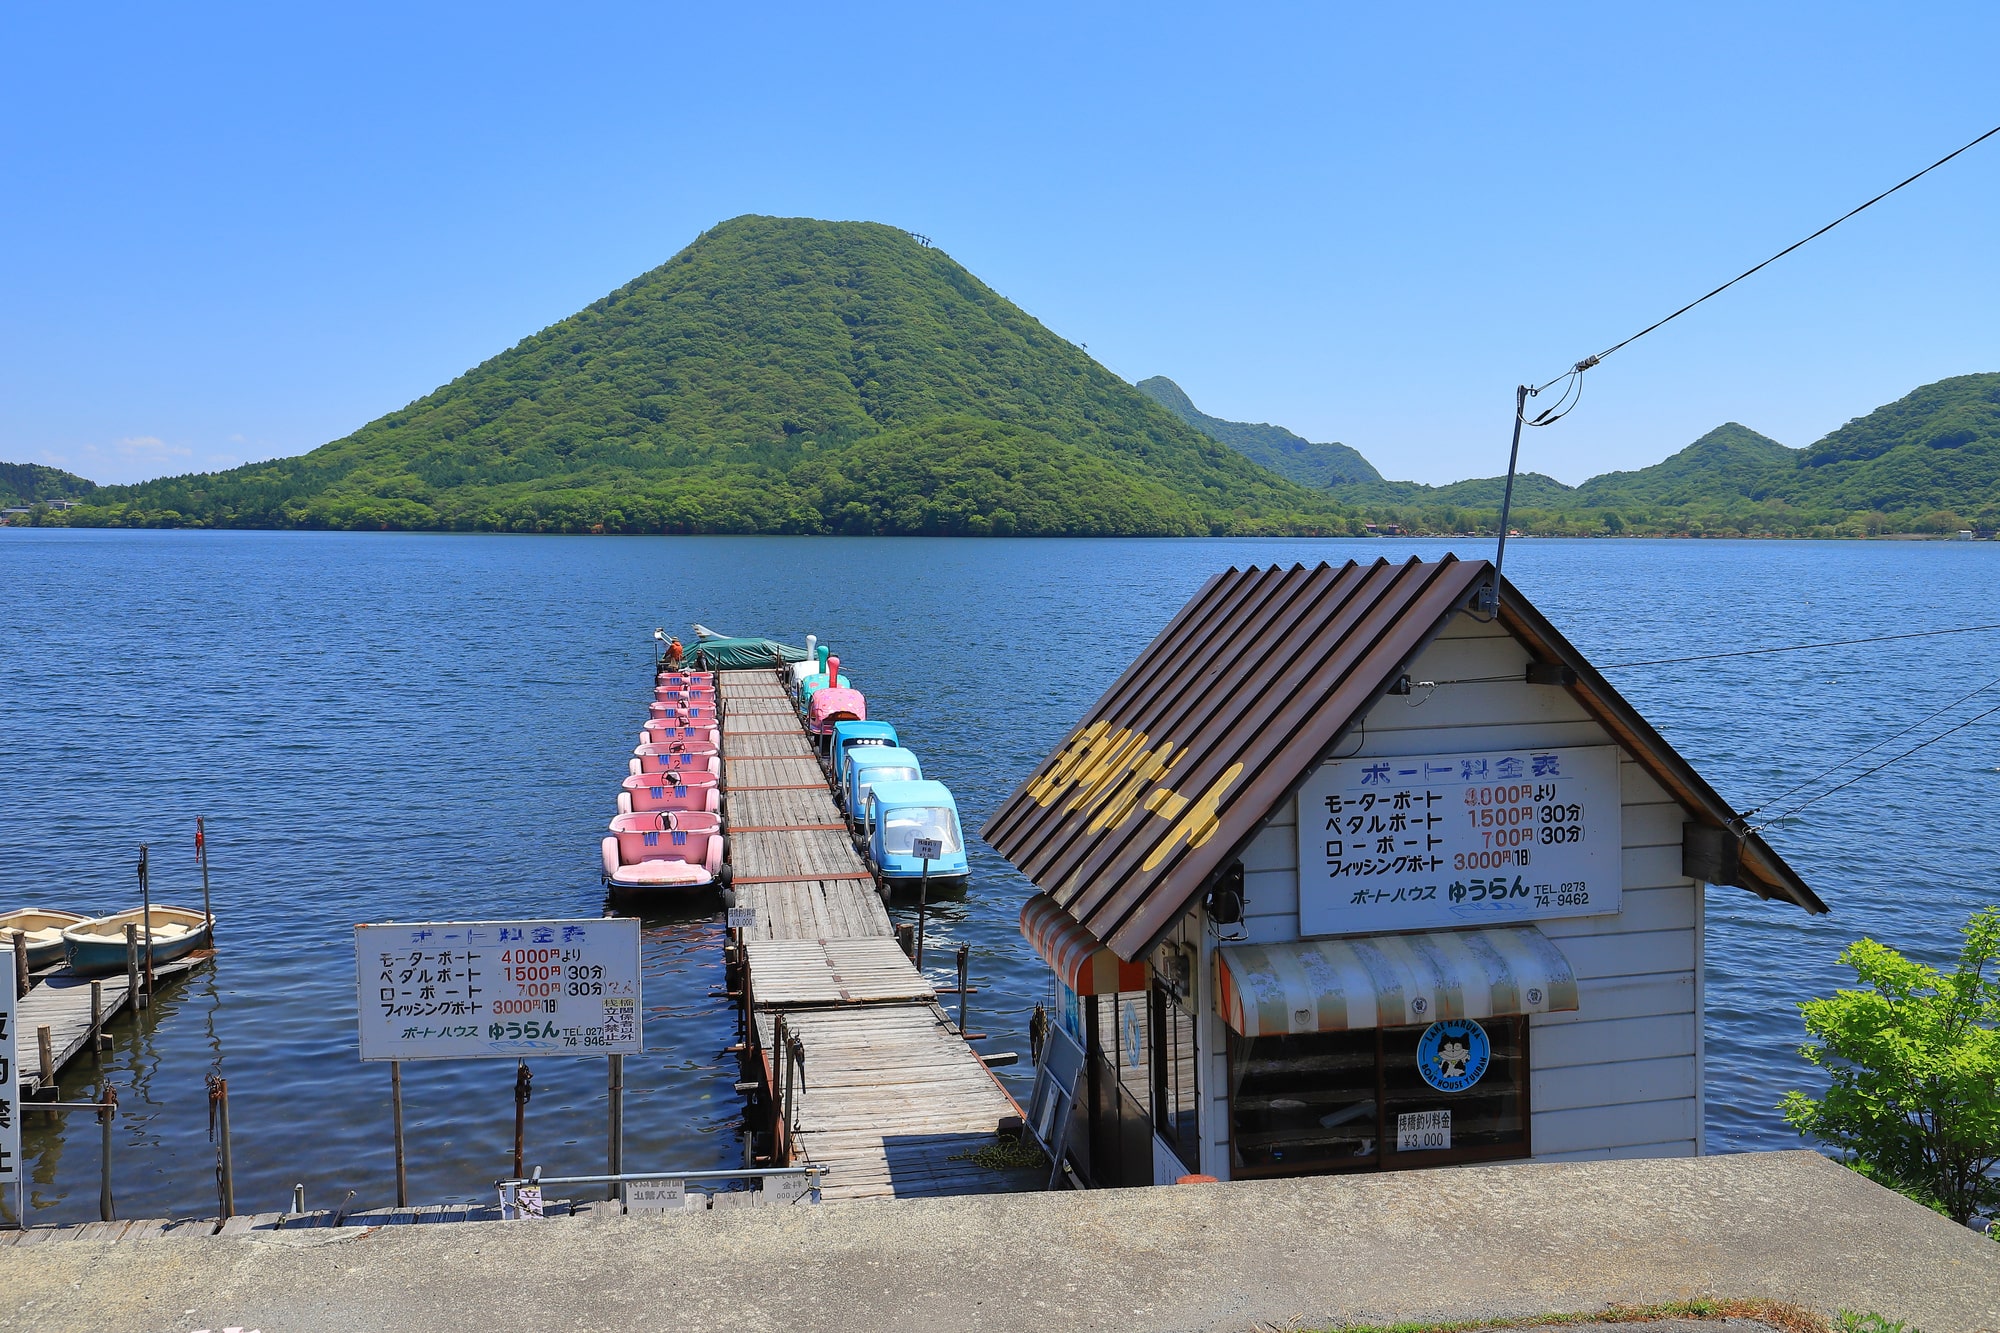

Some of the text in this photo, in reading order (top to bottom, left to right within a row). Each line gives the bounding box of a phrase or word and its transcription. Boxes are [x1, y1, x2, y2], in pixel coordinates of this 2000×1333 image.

[1325, 791, 1442, 813] モーターボート
[1327, 834, 1443, 857] ローボート
[1327, 855, 1443, 877] フィッシングボート
[1350, 875, 1530, 904] ボートハウス ゆうらん
[1534, 893, 1589, 908] 74-9462
[380, 951, 481, 968] モーターボート
[380, 968, 481, 984] ペダルボート
[381, 985, 482, 1001] ローボート
[381, 1001, 482, 1017] フィッシングボート
[402, 1021, 560, 1041] ボートハウス ゆうらん
[563, 1028, 604, 1037] TEL.027
[604, 1007, 620, 1041] 立入禁止
[1425, 1020, 1482, 1042] LAKE HARUNA
[1422, 1057, 1487, 1090] BOAT HOUSE YUURAN
